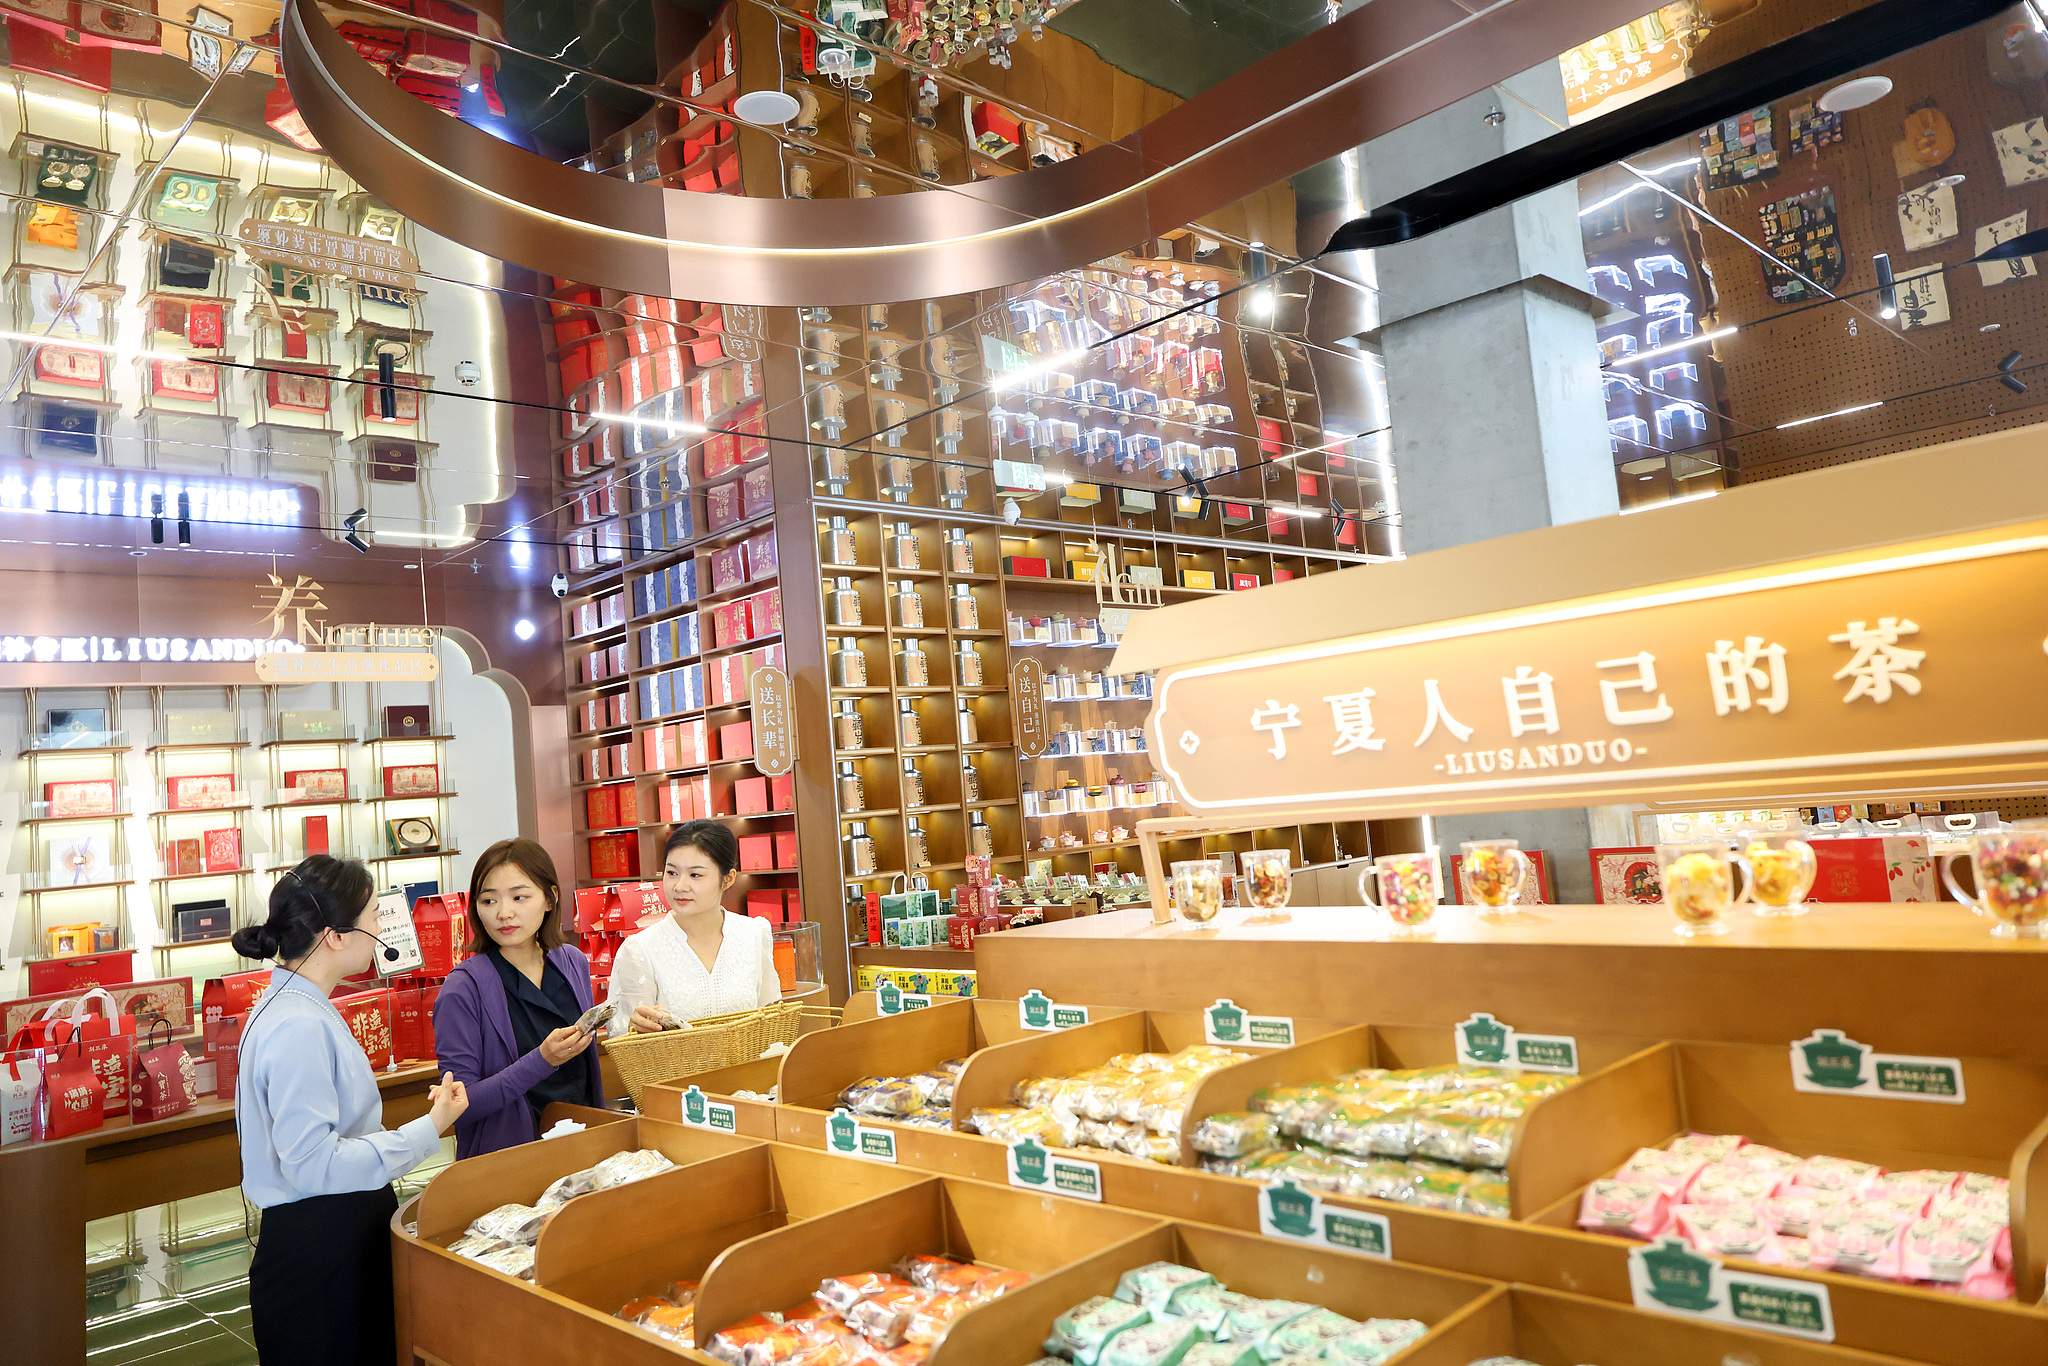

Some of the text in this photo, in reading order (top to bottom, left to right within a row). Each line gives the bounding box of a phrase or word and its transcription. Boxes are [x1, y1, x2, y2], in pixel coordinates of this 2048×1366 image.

[251, 573, 328, 642] 养
[296, 619, 436, 648] Nurture
[274, 657, 422, 671] 滋补养生高端礼品区
[1250, 617, 1926, 760] 宁夏人自己的茶
[759, 687, 778, 750] 送长辈
[1019, 676, 1035, 734] 送自己
[353, 1008, 384, 1039] 非遗
